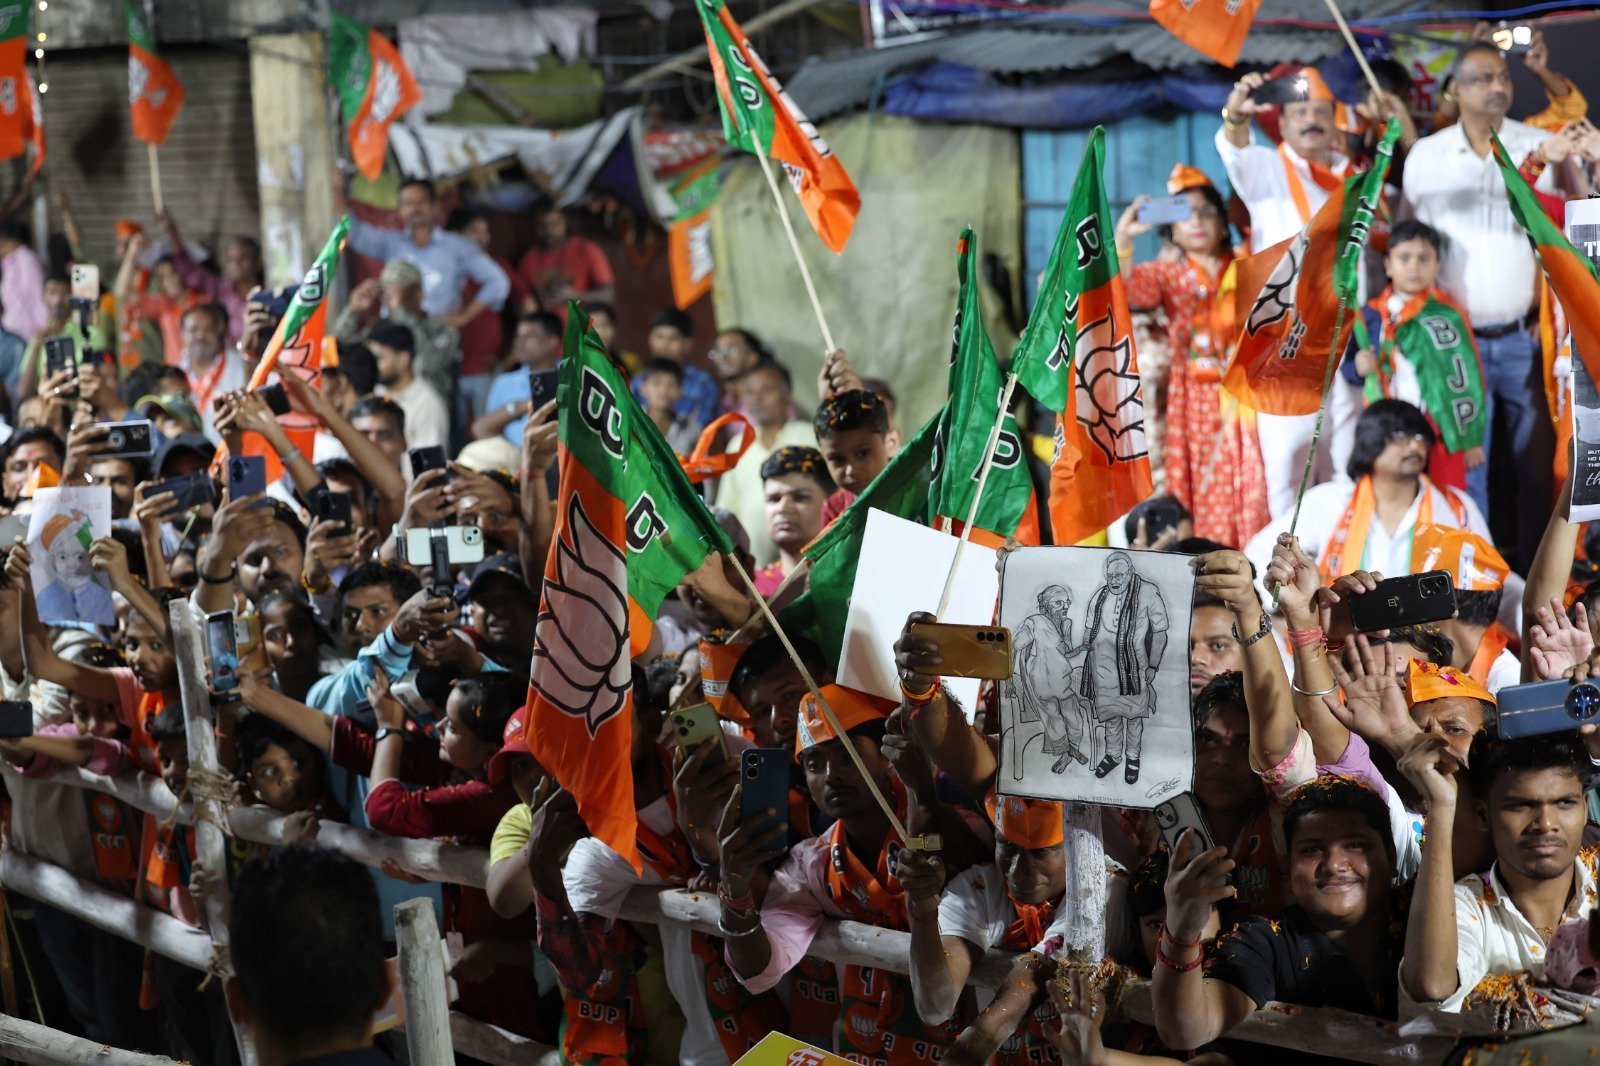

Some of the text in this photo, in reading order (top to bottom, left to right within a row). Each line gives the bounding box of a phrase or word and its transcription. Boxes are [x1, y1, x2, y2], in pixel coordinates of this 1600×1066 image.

[1583, 241, 1600, 257] T
[1418, 315, 1479, 437] BJP
[578, 1000, 620, 1024] BJP
